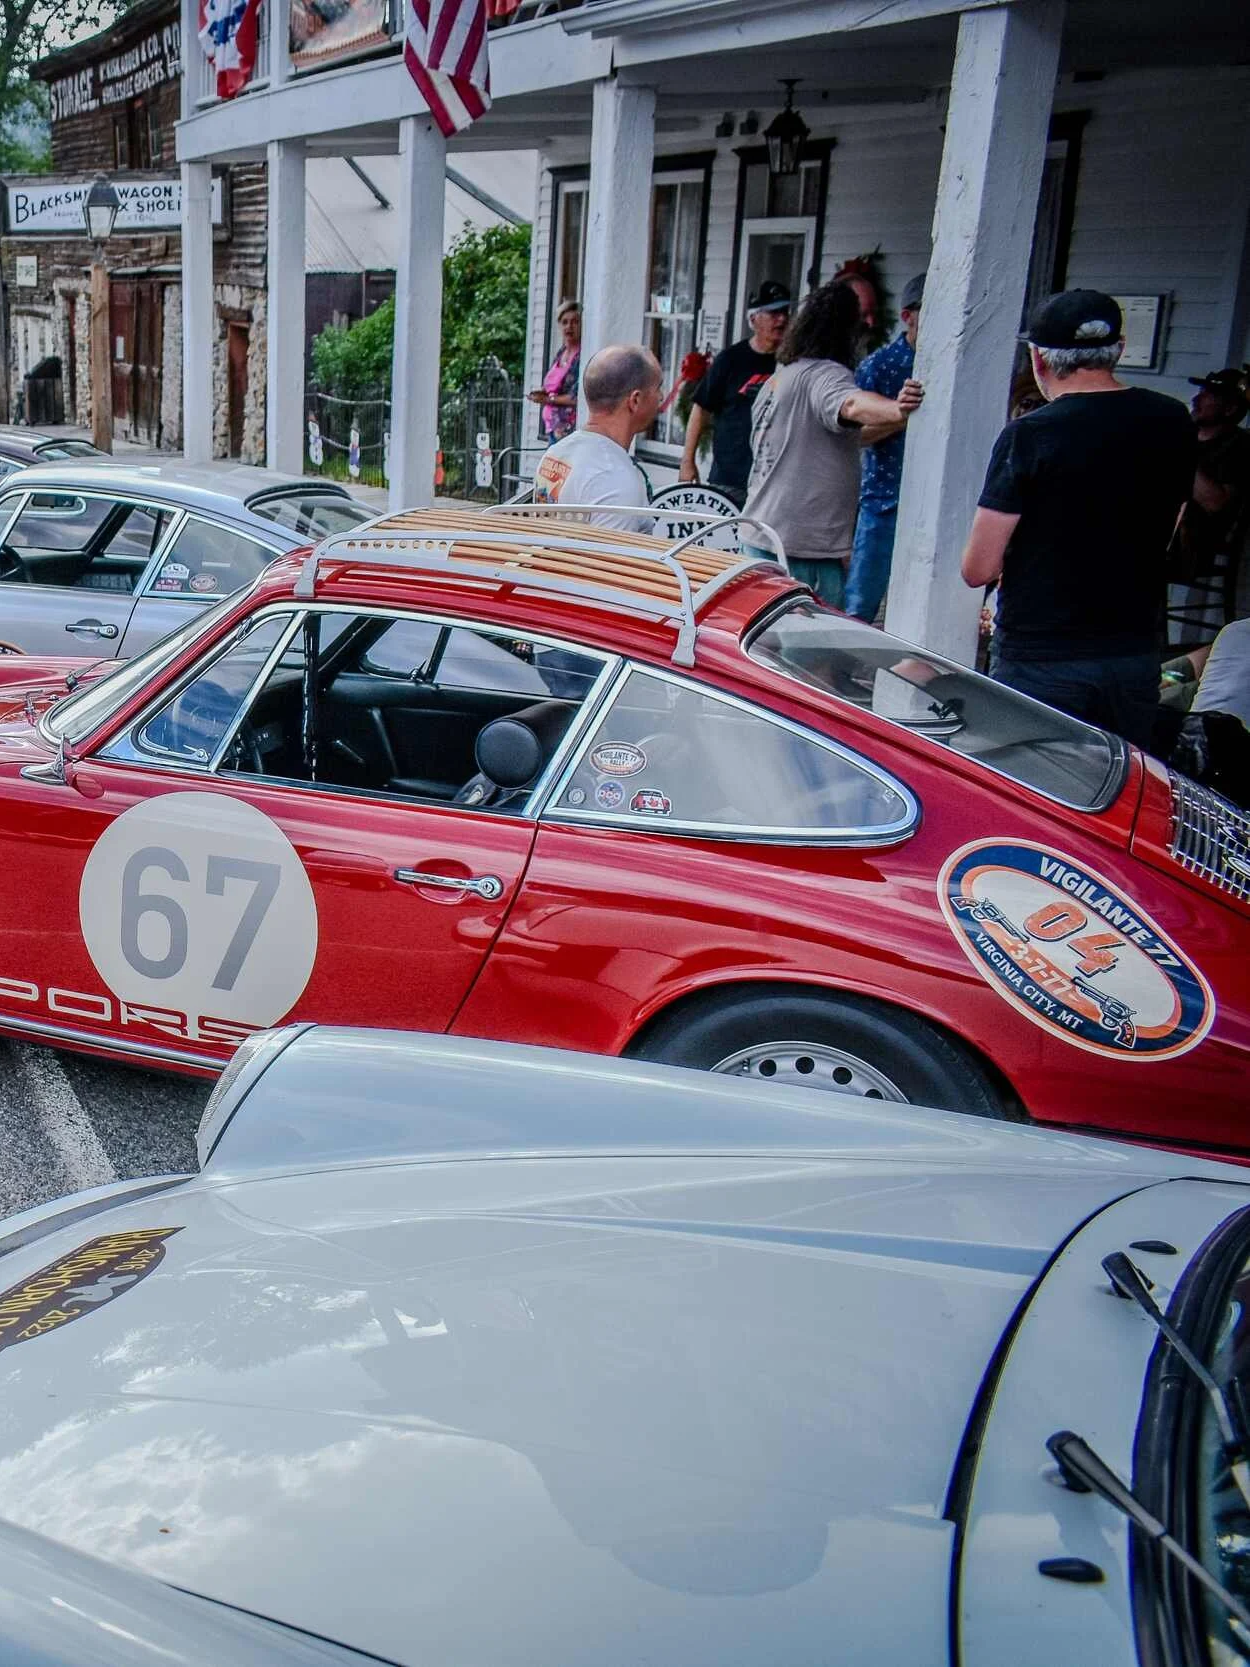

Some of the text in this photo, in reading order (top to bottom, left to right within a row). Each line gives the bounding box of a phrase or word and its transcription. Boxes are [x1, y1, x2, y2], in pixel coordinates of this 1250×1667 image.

[117, 186, 172, 199] WAGON
[667, 522, 713, 539] INN
[600, 750, 630, 762] VIGILANTE
[120, 845, 282, 991] 67
[1039, 856, 1182, 968] VIGILANTE 77
[1023, 901, 1127, 978] 04
[974, 932, 1083, 1030] VIRGINIA CITY, MT
[1010, 942, 1072, 998] 3-7-77
[114, 1248, 161, 1271] 2016
[16, 1308, 81, 1339] 2022
